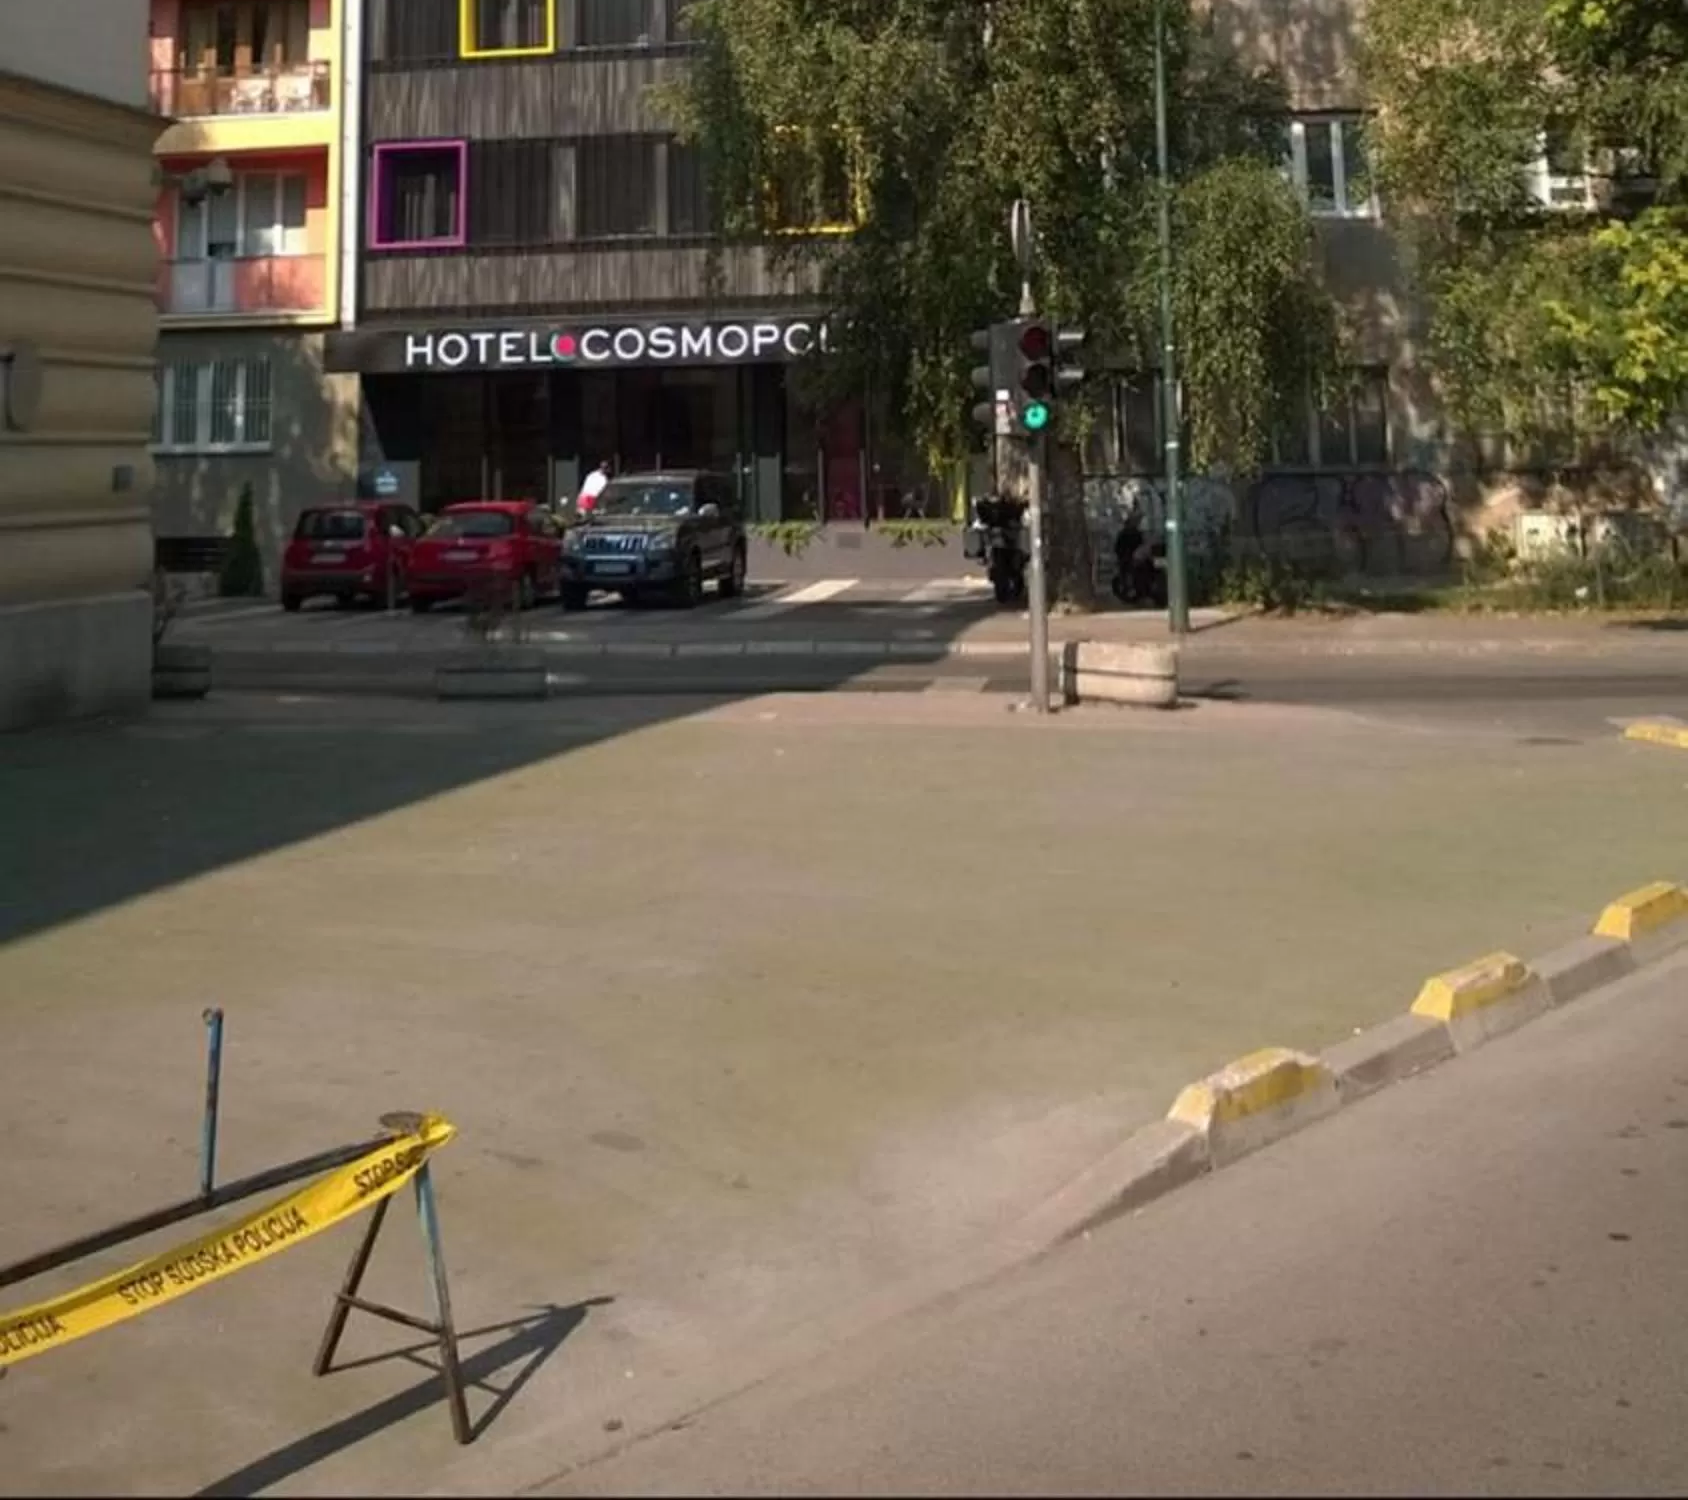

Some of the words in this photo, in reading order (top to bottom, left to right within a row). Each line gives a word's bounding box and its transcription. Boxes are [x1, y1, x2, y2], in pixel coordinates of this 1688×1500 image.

[406, 331, 552, 366] HOTEL
[580, 322, 838, 360] COSMOPOL
[353, 1157, 395, 1198] STOP
[118, 1270, 164, 1305] STOP
[165, 1241, 241, 1286] SUDSKA
[233, 1206, 308, 1255] POLICIJA
